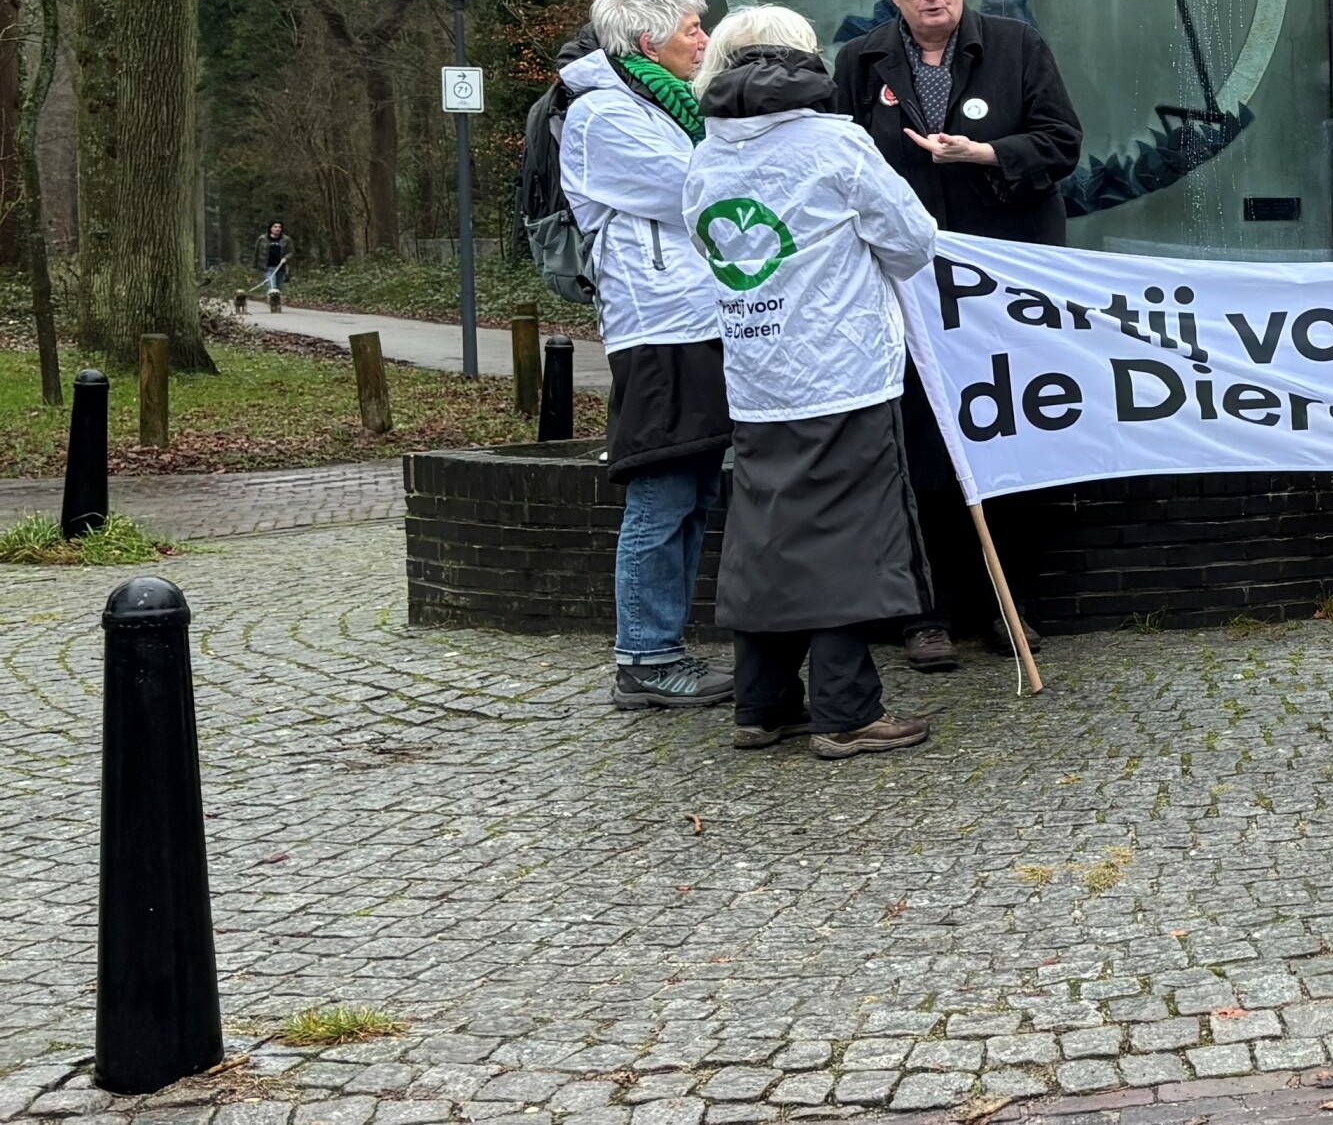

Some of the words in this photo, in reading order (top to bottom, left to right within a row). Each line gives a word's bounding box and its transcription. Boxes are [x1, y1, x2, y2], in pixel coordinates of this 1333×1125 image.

[734, 322, 781, 339] Dieren
[746, 298, 785, 314] voor
[933, 253, 1208, 363] Partij
[958, 352, 1083, 442] de
